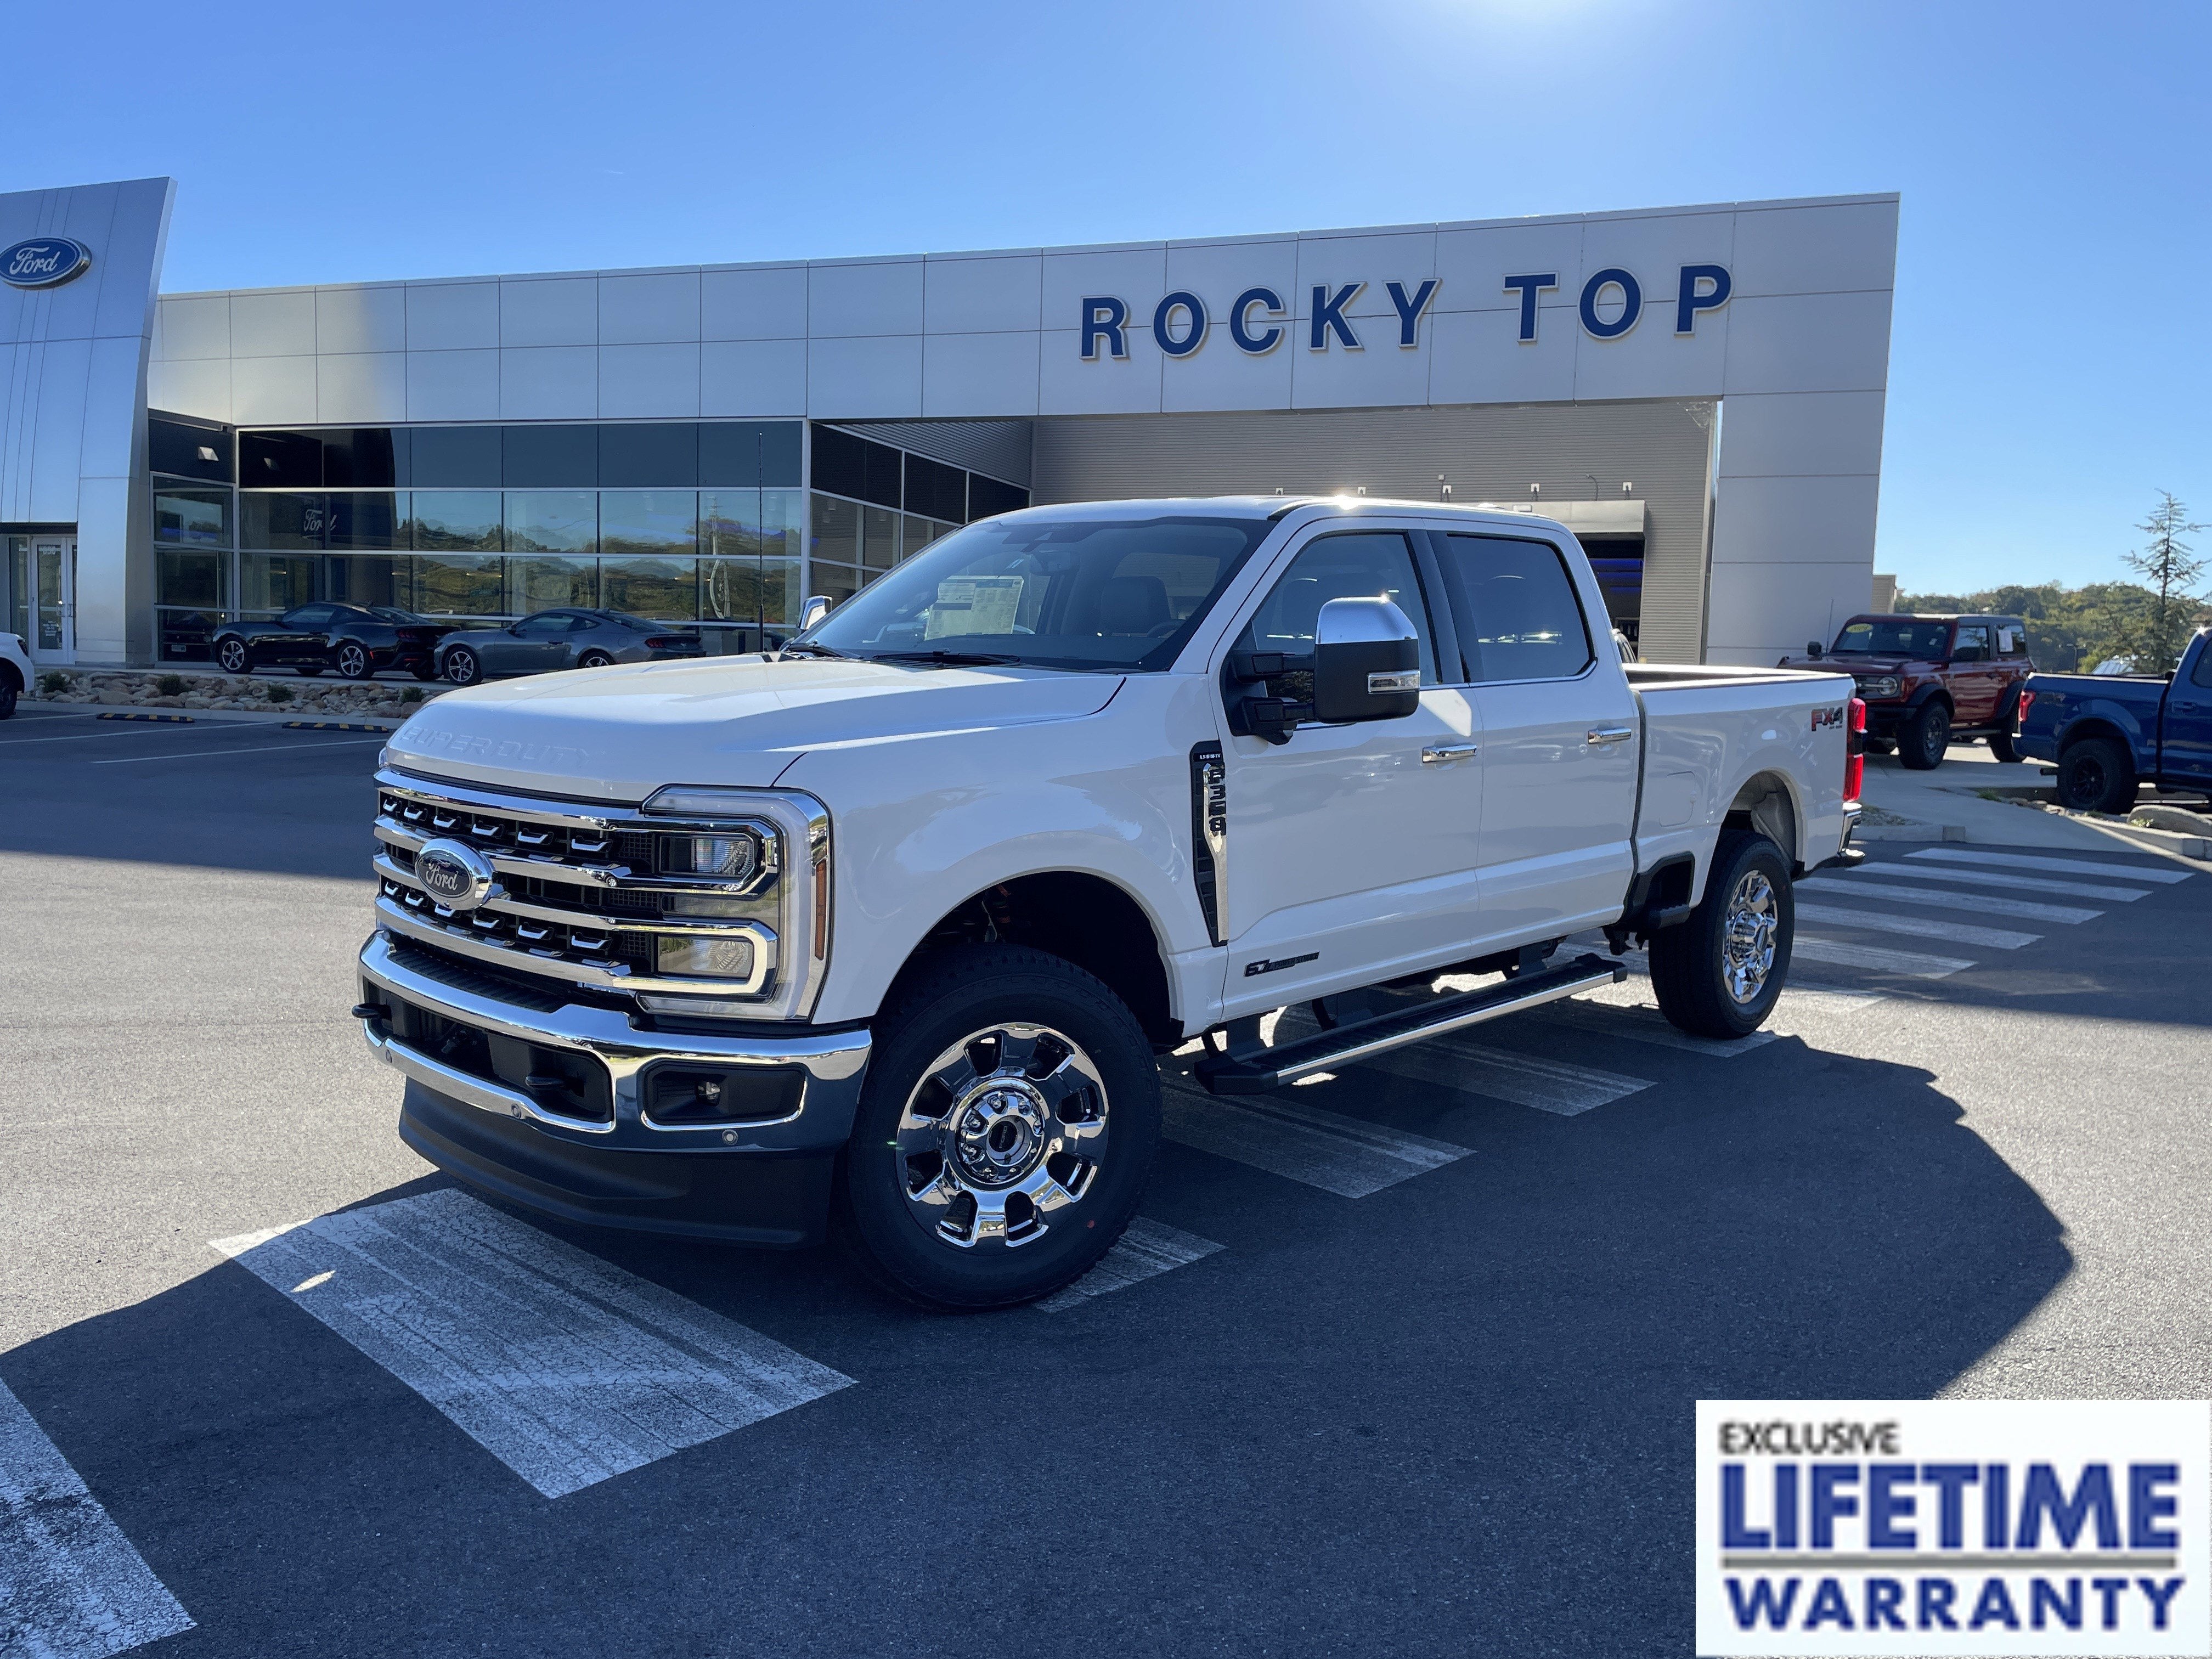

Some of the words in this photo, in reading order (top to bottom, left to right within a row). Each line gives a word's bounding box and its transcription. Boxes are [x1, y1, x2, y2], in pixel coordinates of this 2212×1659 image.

[9, 247, 61, 275] Ford
[1079, 276, 1442, 360] ROCKY
[1502, 262, 1733, 344] TOP
[1812, 707, 1843, 731] FX4
[399, 726, 493, 756] SUPER
[426, 857, 459, 891] Ford
